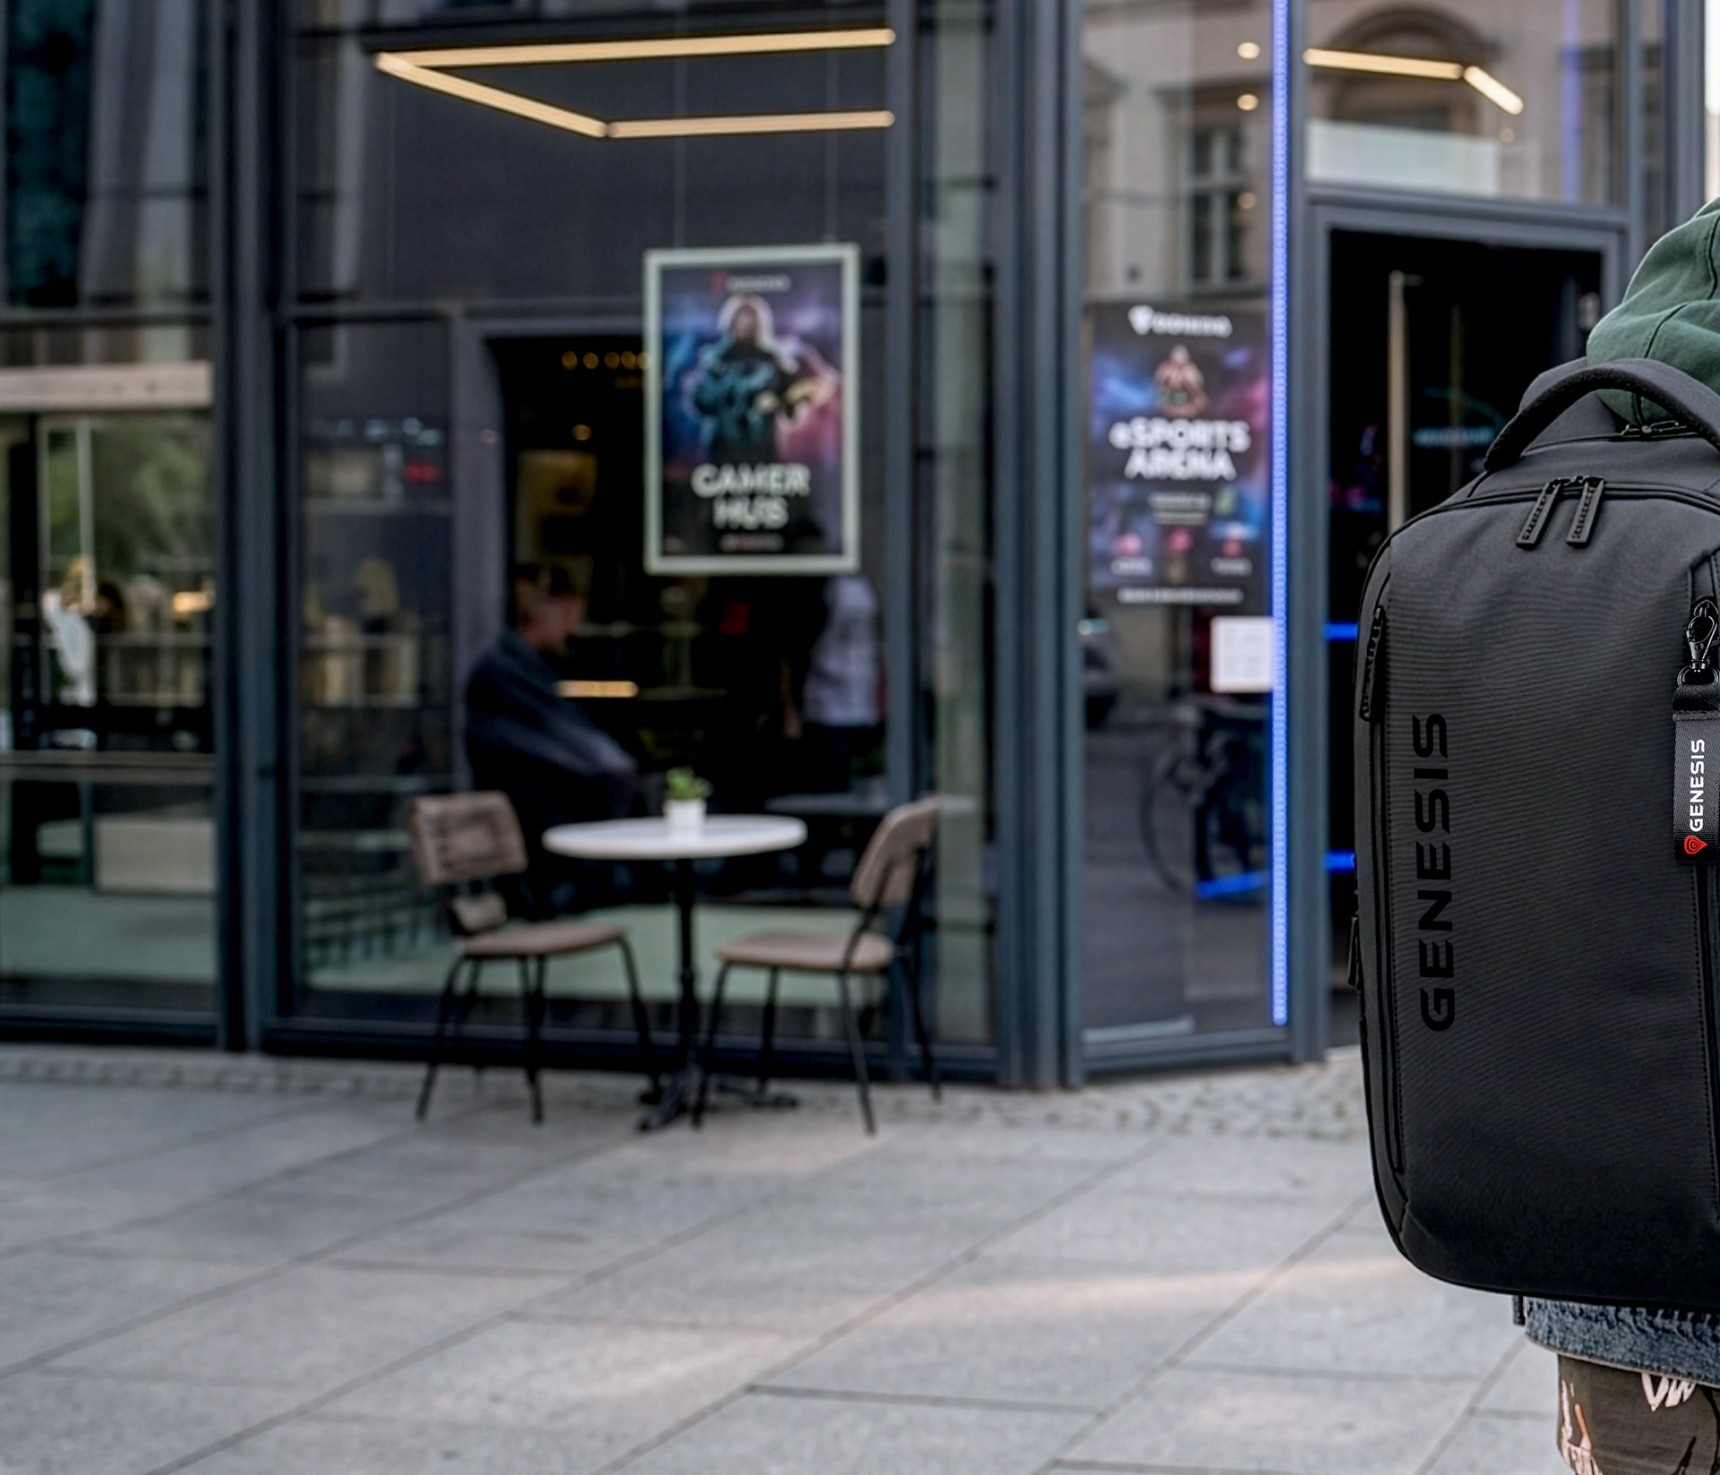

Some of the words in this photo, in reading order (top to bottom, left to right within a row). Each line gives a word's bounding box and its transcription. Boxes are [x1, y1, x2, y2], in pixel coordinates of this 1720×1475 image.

[1125, 449, 1235, 481] ARENA
[714, 498, 788, 529] HUB
[1690, 739, 1706, 832] GENESIS
[1412, 713, 1456, 1032] GENESIS
